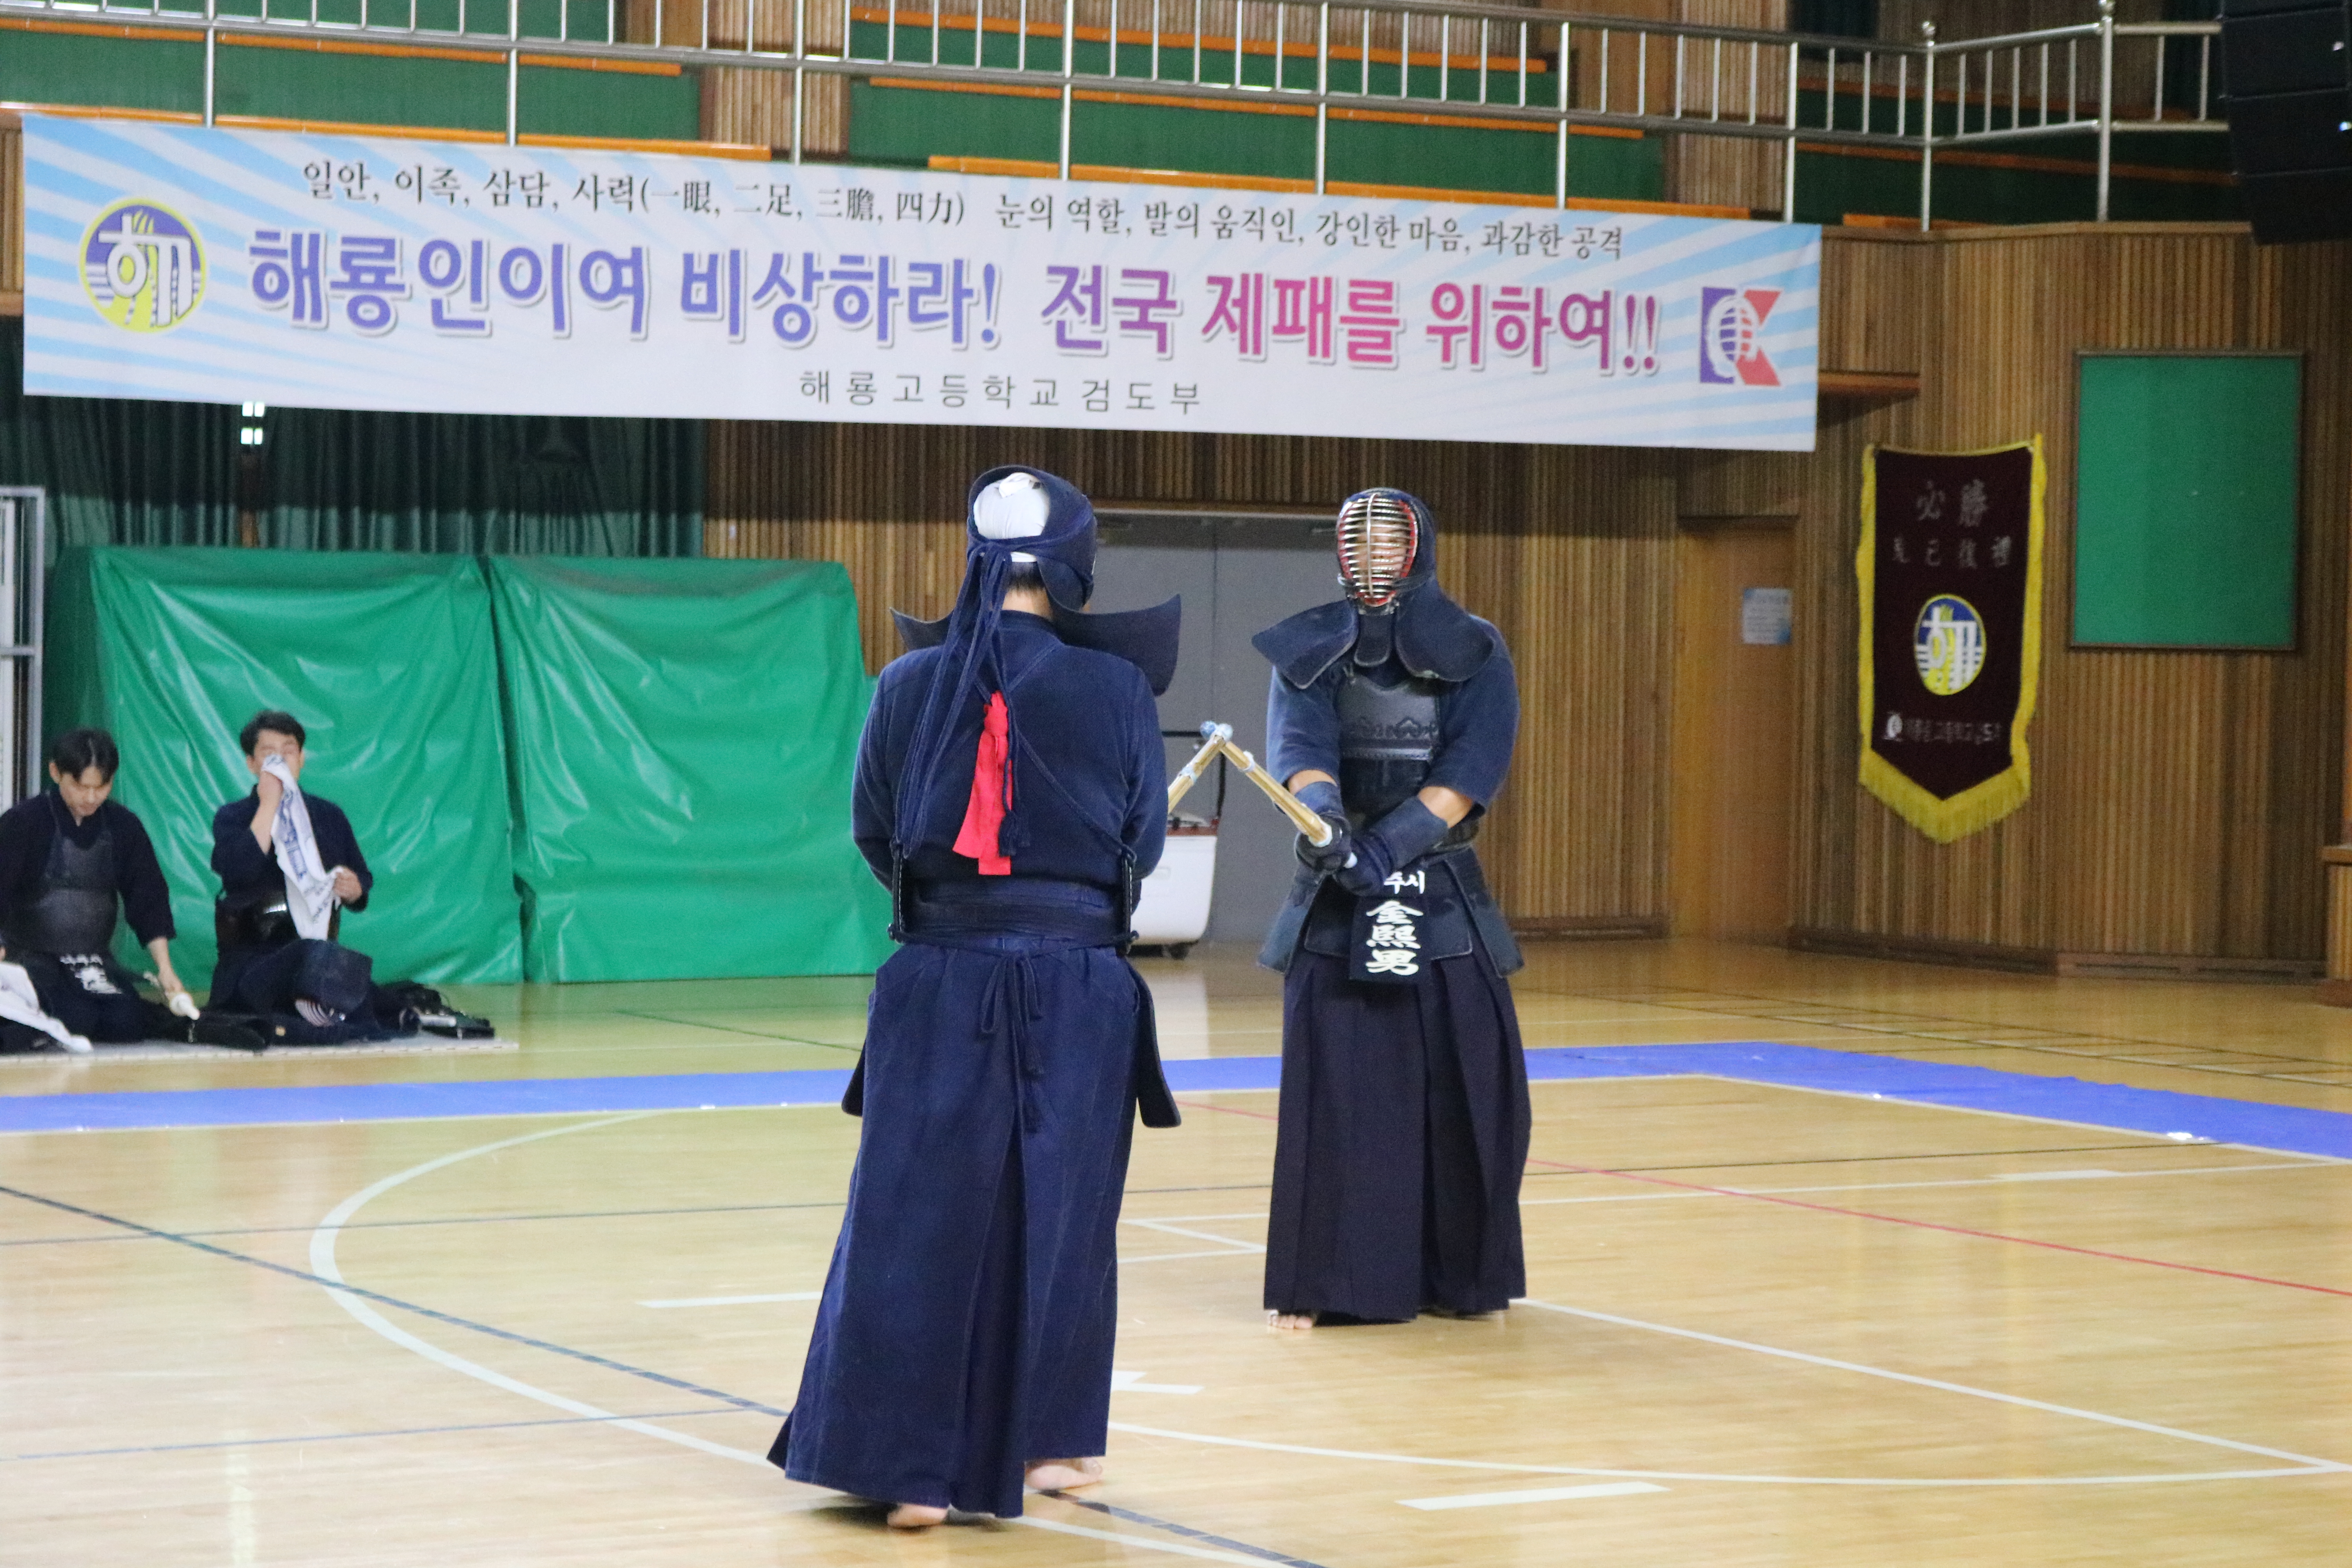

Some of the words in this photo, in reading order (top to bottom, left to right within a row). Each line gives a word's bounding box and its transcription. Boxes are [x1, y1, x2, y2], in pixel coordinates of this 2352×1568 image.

[303, 160, 380, 202] 일안,
[394, 164, 470, 207] 이족,
[484, 169, 559, 211] 삼담,
[734, 183, 803, 220] 二足,
[996, 194, 1053, 232] 눈의
[1066, 197, 1132, 236] 역할,
[1144, 201, 1200, 239] 발의
[1211, 205, 1305, 244] 움직인,
[1316, 211, 1400, 249] 강인한
[1409, 217, 1470, 252] 마음,
[1481, 221, 1563, 258] 과감한
[1572, 227, 1622, 261] 공격
[249, 228, 645, 333] 해룡인이여
[681, 249, 996, 344] 비상하라!
[1042, 265, 1178, 354] 전국
[1201, 272, 1402, 365] 제패를
[1425, 281, 1656, 370] 위하여!!
